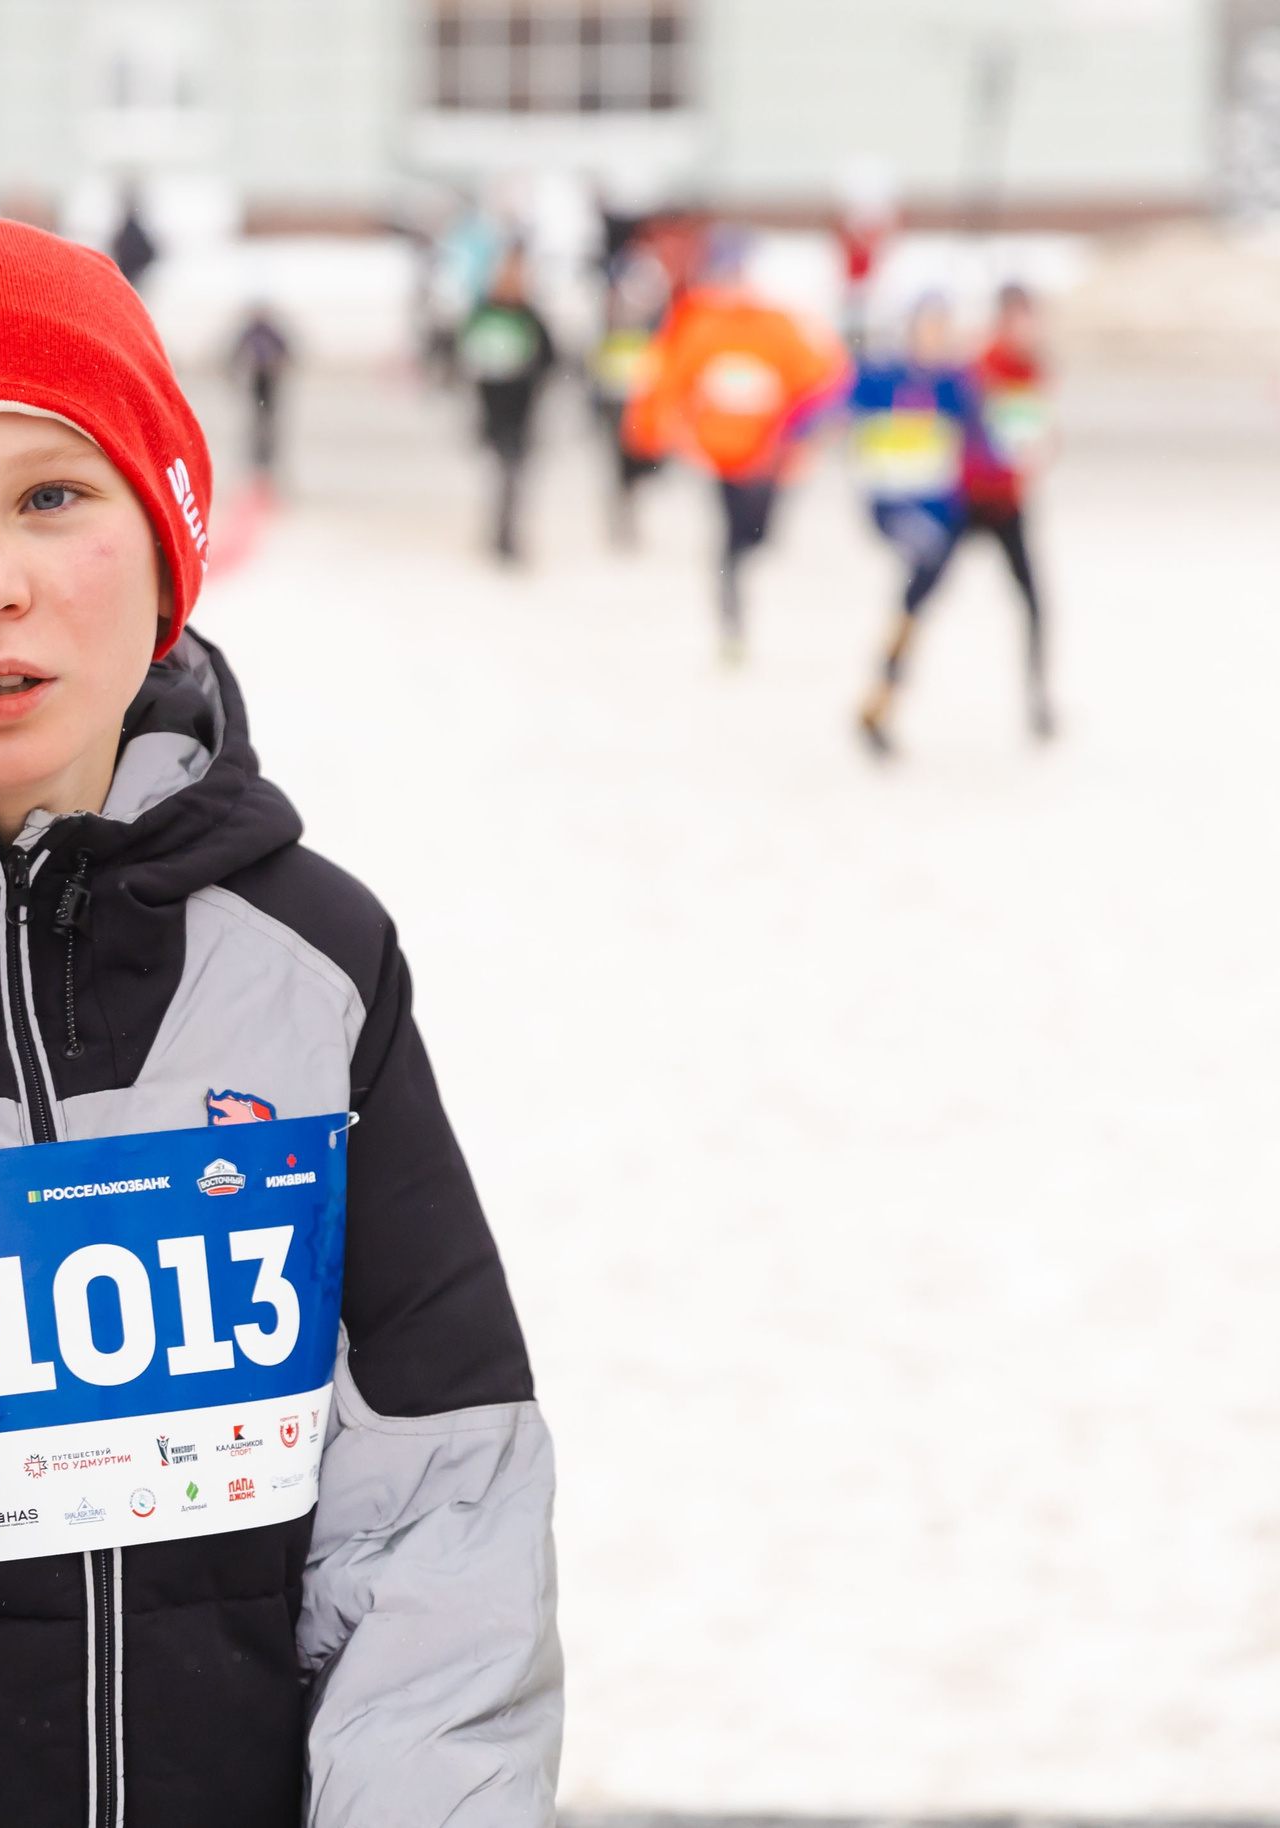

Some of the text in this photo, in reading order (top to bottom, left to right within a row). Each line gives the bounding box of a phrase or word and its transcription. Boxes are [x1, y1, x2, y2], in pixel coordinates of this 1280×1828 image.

[43, 1176, 171, 1201] РОССЕЛЬХОЗБАНК
[200, 1175, 244, 1189] ВОСТОЧНЫЙ
[171, 1444, 196, 1455] МИНСПОРТ
[216, 1439, 263, 1452] КАЛАШНИКОВ
[230, 1448, 252, 1457] СПОРТ
[52, 1447, 111, 1461] ПУТЕШЕСТВУЙ
[53, 1454, 132, 1472] ПО УДМУРТИИ
[228, 1478, 255, 1493] ПАПА
[229, 1490, 256, 1502] ДЖОНС
[7, 1508, 38, 1523] HAS
